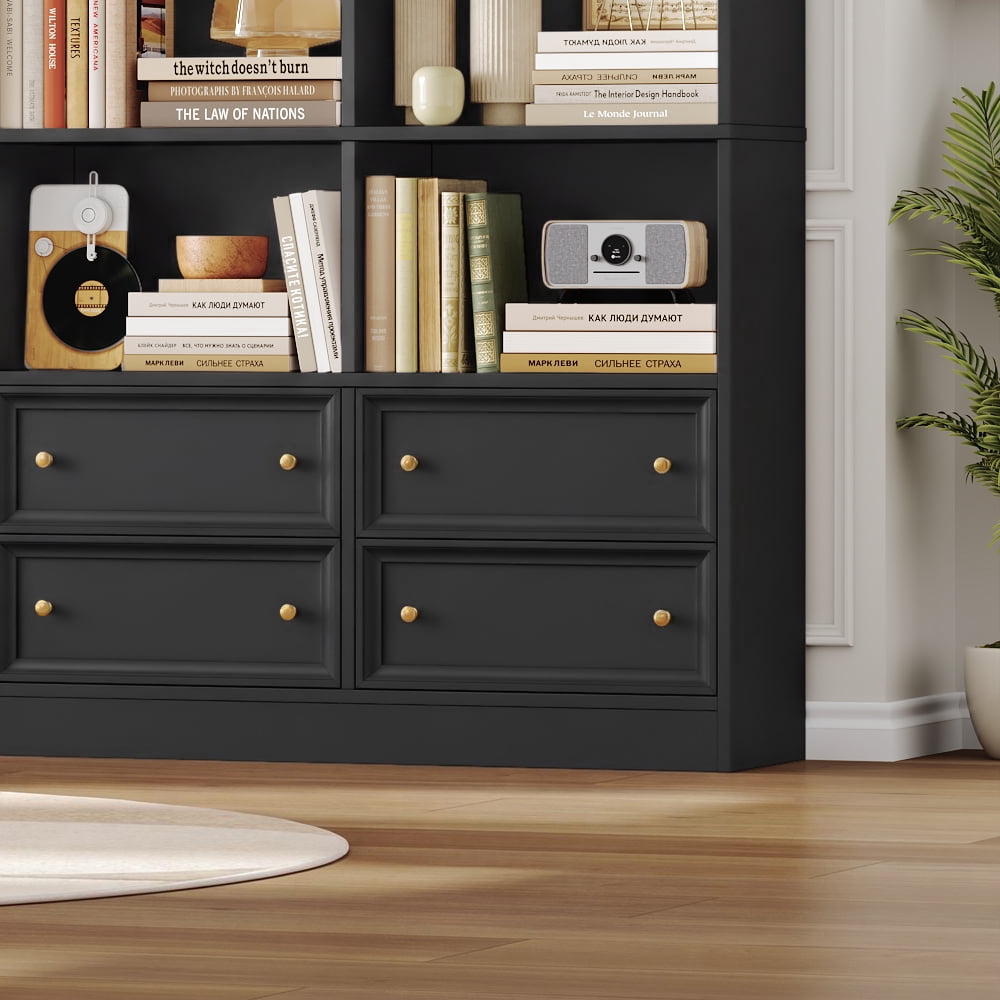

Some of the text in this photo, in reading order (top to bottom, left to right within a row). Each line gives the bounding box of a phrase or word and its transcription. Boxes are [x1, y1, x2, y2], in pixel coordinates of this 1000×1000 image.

[48, 8, 56, 70] WILTON HOUSE
[70, 18, 80, 59] TEXTURES
[174, 61, 194, 76] the
[196, 60, 229, 75] witch
[280, 60, 309, 74] burn
[170, 85, 316, 98] PHOTOGRAPHS BY FRANÇOIS HALARD
[594, 89, 699, 100] The Interior Design Handbook
[176, 107, 305, 120] THE LAW OF NATIONS
[584, 110, 594, 118] Le
[632, 110, 668, 118] Journal
[282, 236, 309, 338] СПАСИТЕ КОТИКА!
[609, 314, 639, 323] ЛЮДИ
[641, 314, 683, 323] ДУМАЮТ
[328, 322, 339, 359] проектами
[594, 360, 641, 368] СИЛЬНЕЕ
[645, 360, 681, 368] СТРАХА
